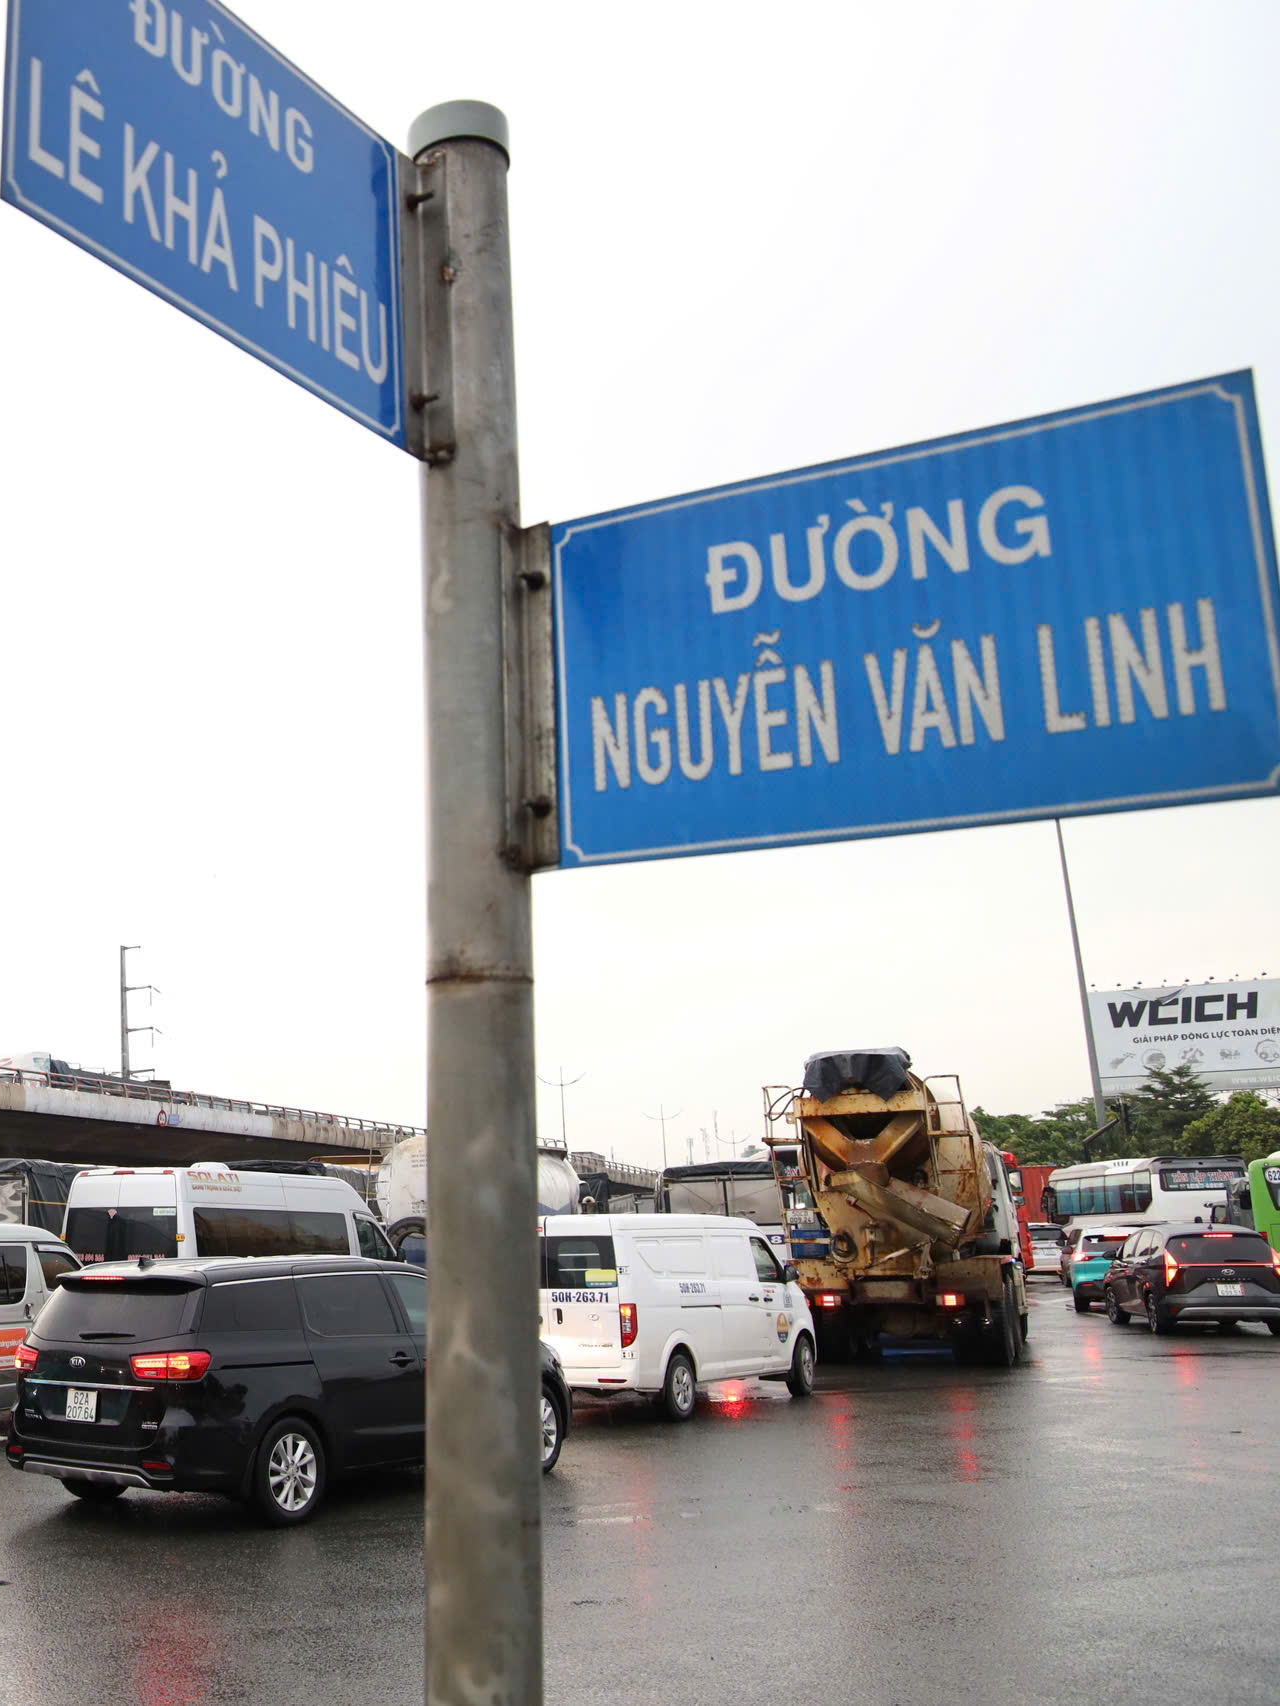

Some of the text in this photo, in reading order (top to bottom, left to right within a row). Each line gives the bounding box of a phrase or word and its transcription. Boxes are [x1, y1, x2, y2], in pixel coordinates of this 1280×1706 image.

[130, 0, 314, 174] ĐƯỜNG
[29, 57, 388, 386] LÊ KHẢ PHIÊU
[705, 485, 1053, 615] ĐƯỜNG
[590, 598, 1228, 794] NGUYỄN VĂN LINH
[187, 1170, 240, 1184] SOLATI
[551, 1291, 609, 1303] 50H-263.71
[66, 1406, 94, 1420] 207.64
[73, 1391, 89, 1406] 62A
